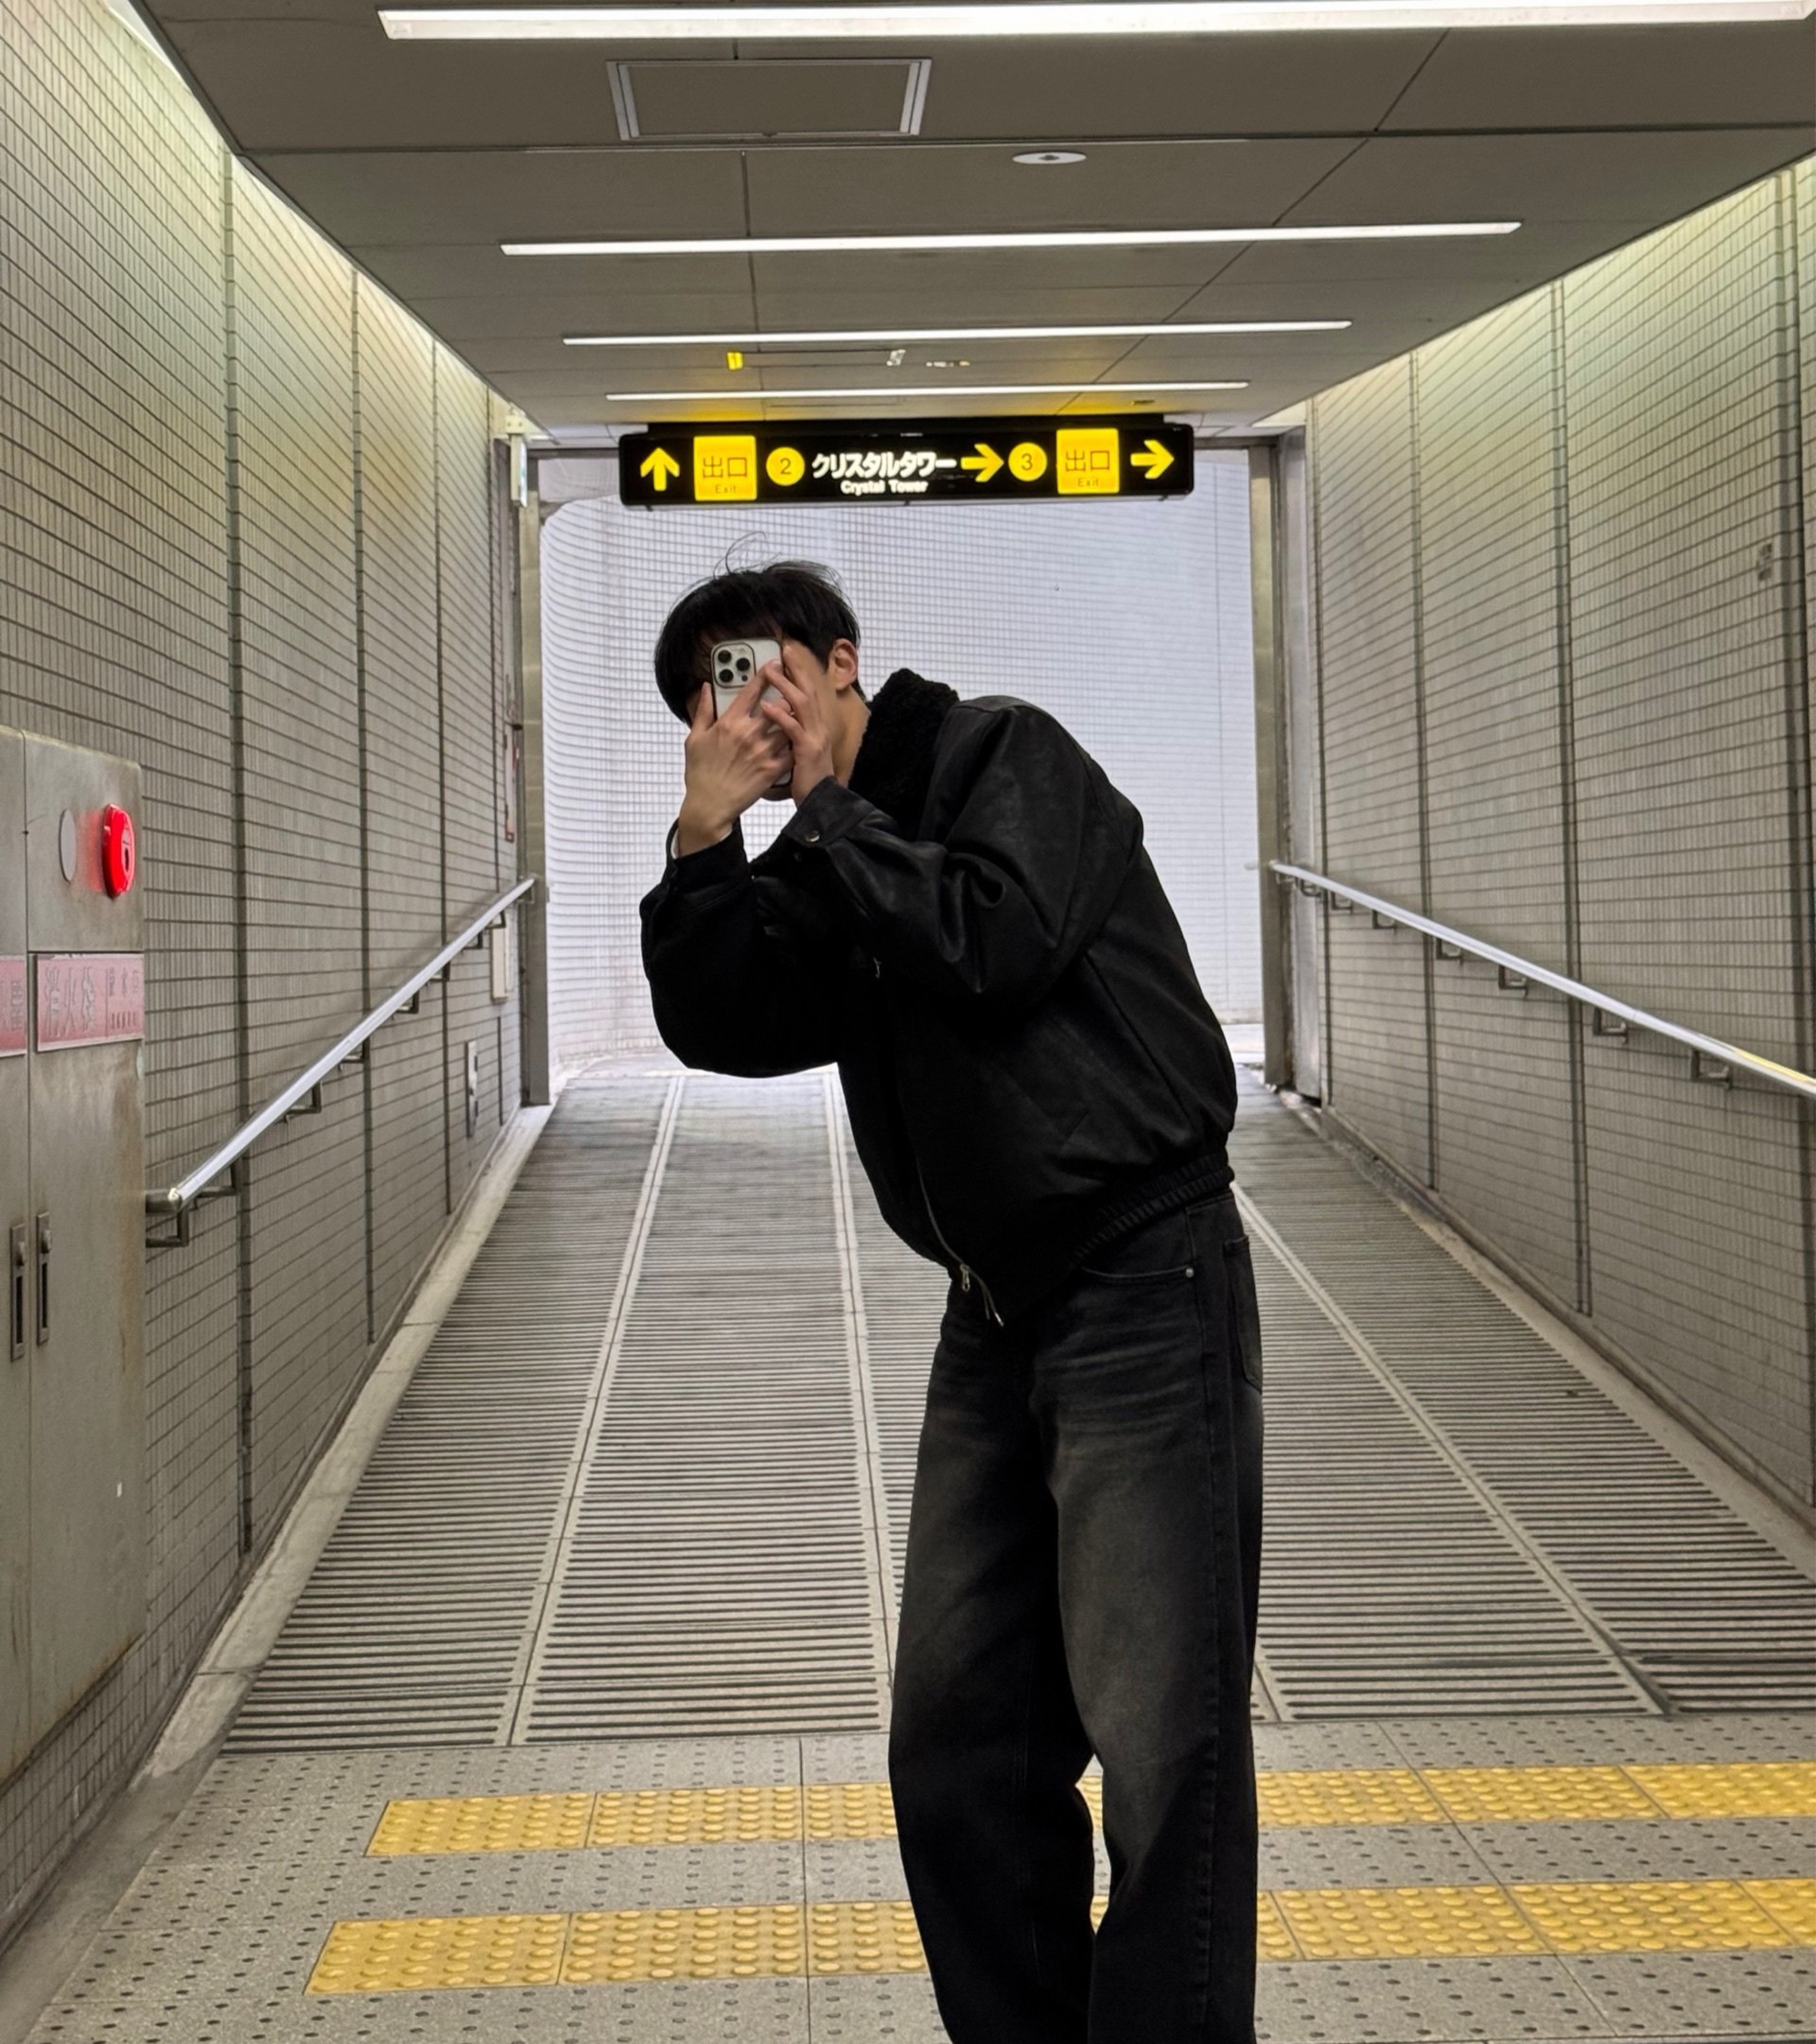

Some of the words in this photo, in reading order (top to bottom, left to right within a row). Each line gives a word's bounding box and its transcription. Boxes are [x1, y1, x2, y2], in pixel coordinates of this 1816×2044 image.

[702, 456, 747, 478] 出口
[780, 457, 792, 475] 2
[812, 451, 957, 479] クリスタルタワー
[1021, 452, 1033, 471] 3
[1066, 449, 1110, 472] 出口
[715, 484, 736, 493] Exit
[840, 479, 885, 496] Crystal
[888, 479, 929, 493] Tower
[1078, 478, 1099, 487] Exit
